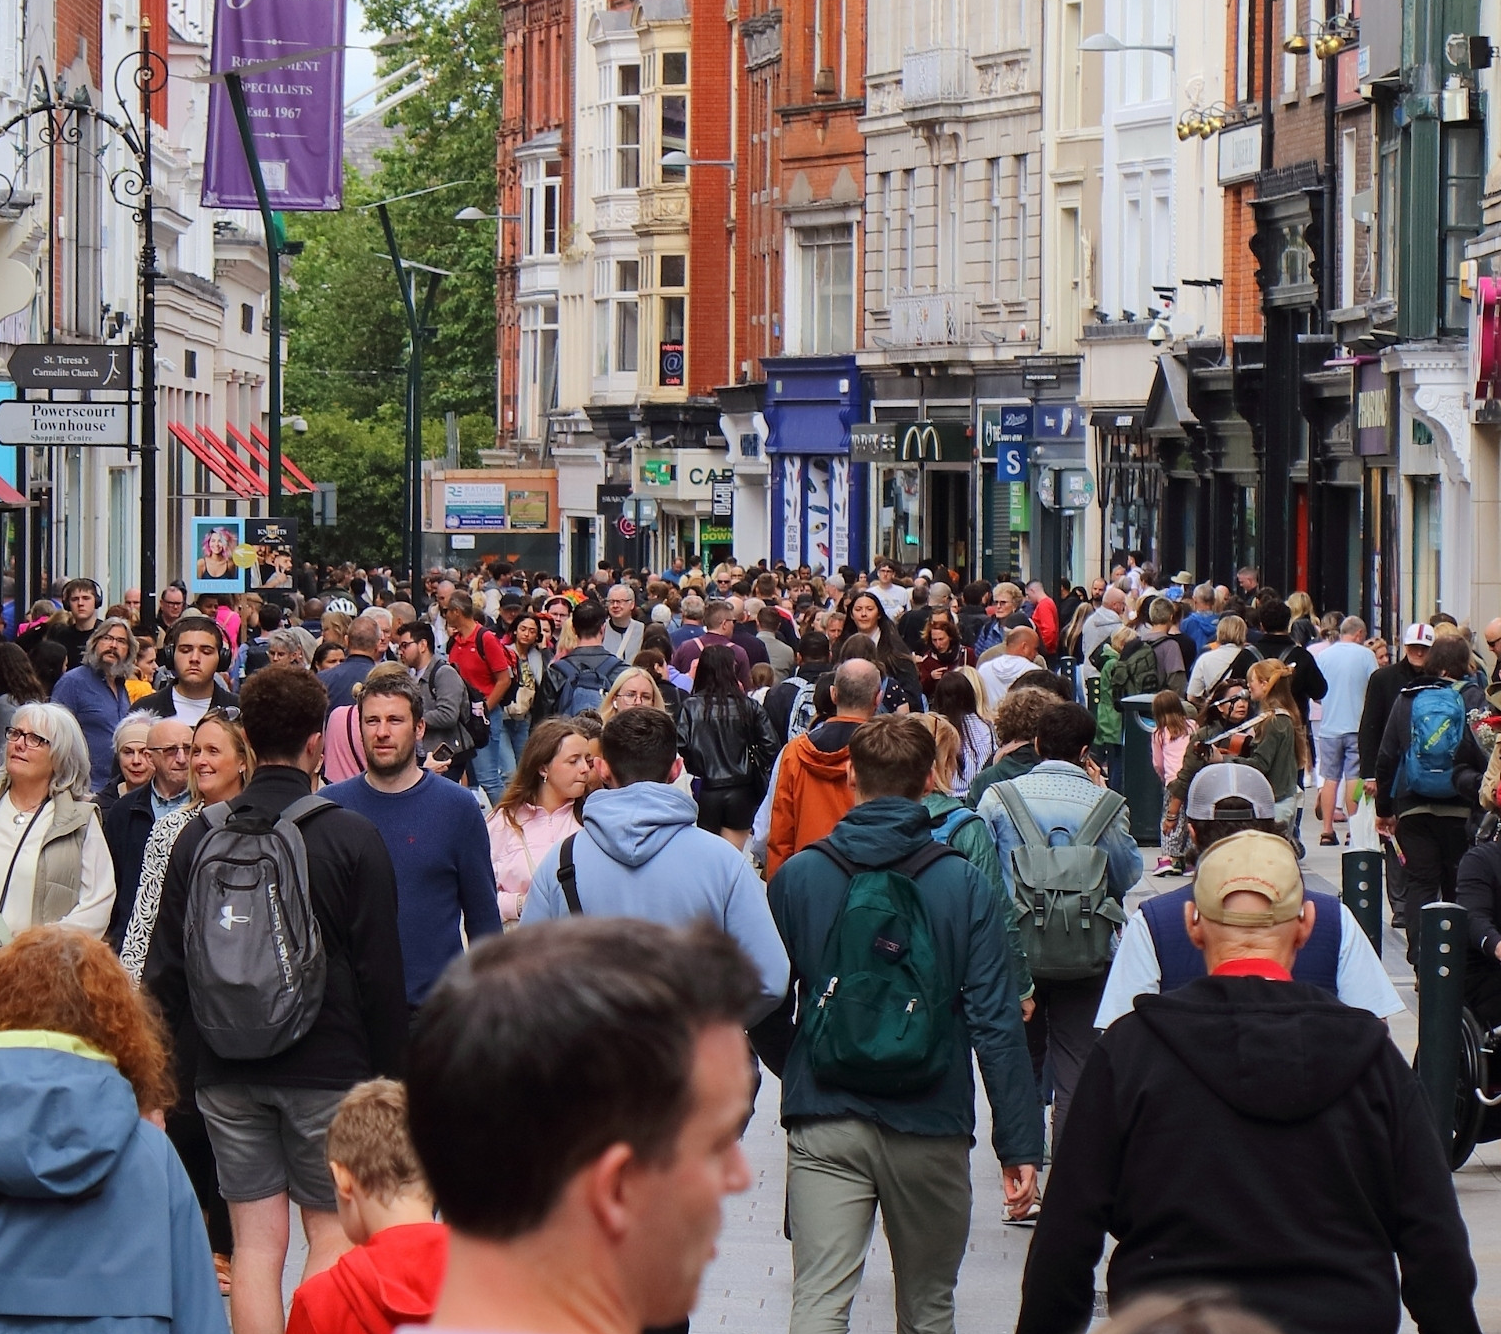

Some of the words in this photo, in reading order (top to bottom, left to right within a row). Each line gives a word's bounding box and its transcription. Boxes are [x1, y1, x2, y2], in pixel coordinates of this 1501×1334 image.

[247, 106, 271, 118] Estd.
[275, 106, 301, 119] 1967
[44, 355, 55, 365] St.
[57, 355, 89, 365] Teresa's
[33, 368, 70, 377] Carmelite
[71, 368, 99, 377] Church
[31, 404, 116, 418] Powerscourt
[1358, 388, 1387, 429] PHARMAC
[31, 419, 107, 432] Townhouse
[31, 434, 65, 443] Shopping
[68, 434, 93, 442] Centre
[1423, 718, 1451, 751] HEAD
[268, 883, 282, 932] UNDER
[276, 934, 294, 994] ARMOUR
